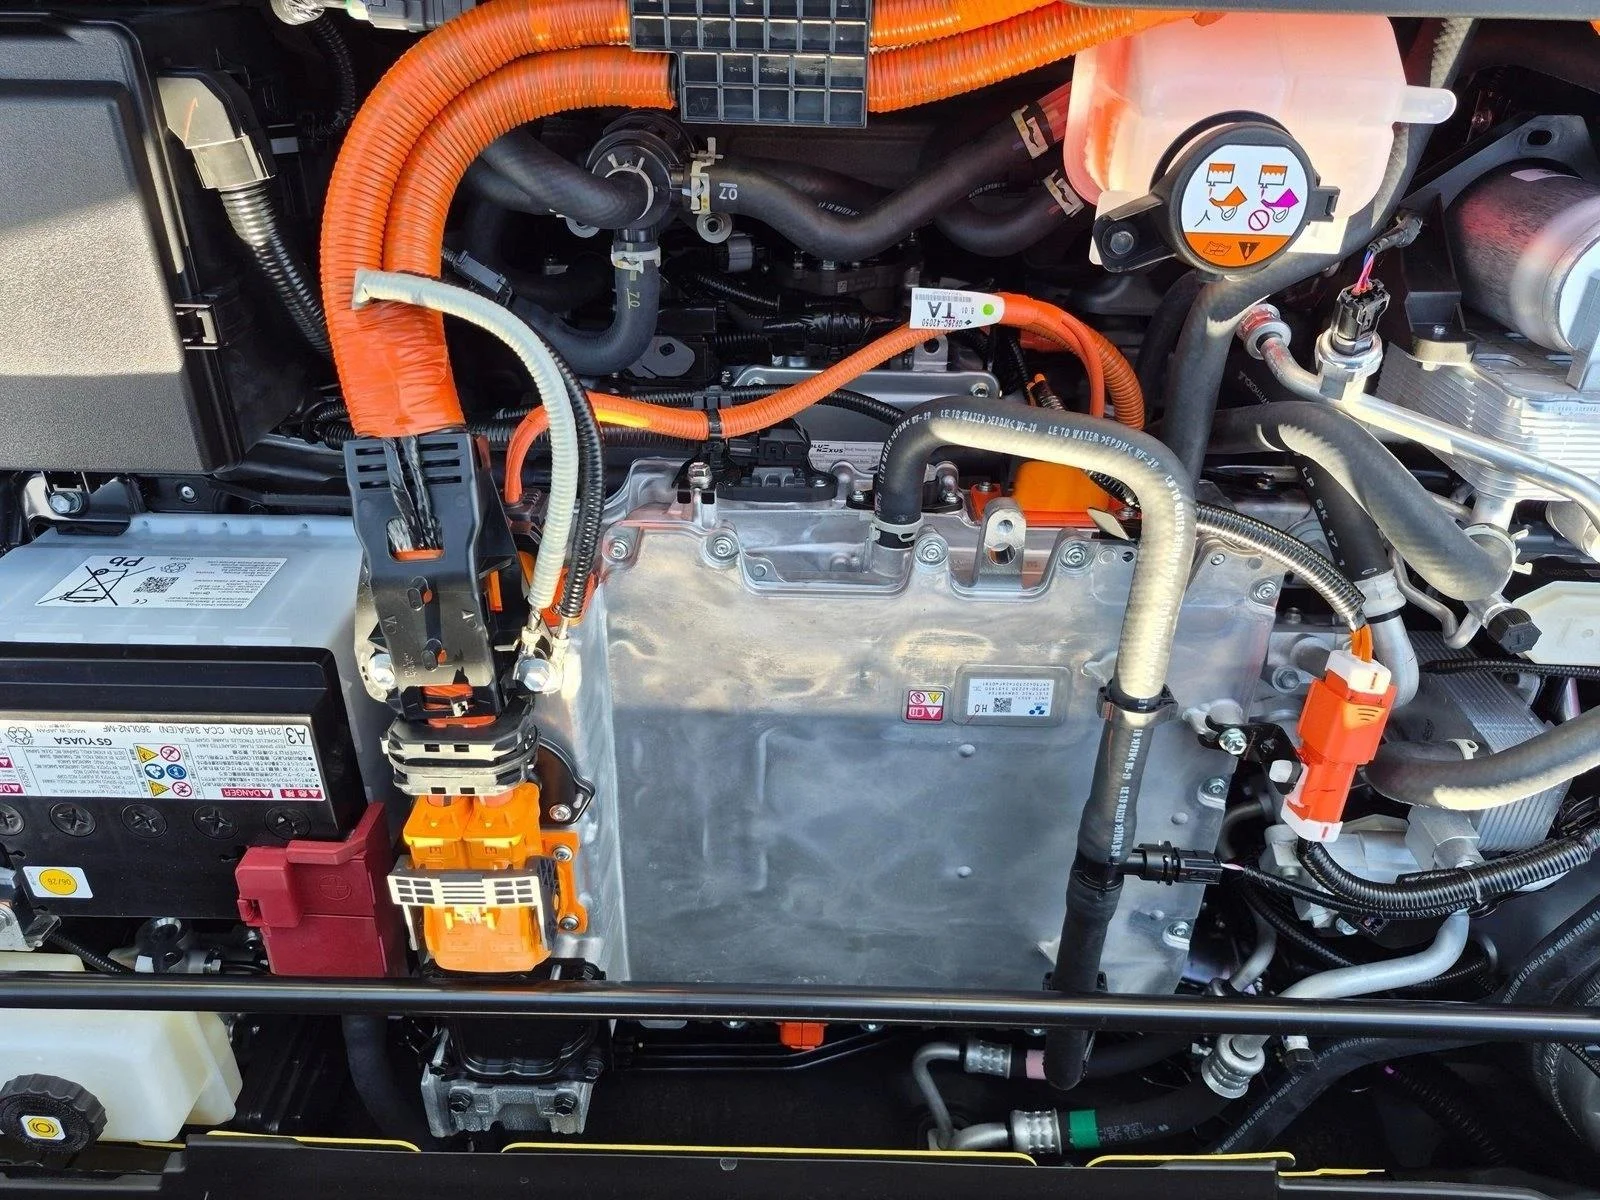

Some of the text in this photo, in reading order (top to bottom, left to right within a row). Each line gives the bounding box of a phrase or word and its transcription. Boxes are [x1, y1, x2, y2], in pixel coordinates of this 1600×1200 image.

[718, 187, 738, 201] 07
[928, 302, 956, 319] TA
[1071, 428, 1099, 443] WATER
[108, 556, 145, 567] Pb
[158, 725, 200, 735] 345A(EN)
[203, 726, 225, 736] CCA
[229, 727, 254, 736] 60Ah
[256, 727, 281, 736] 20HR
[285, 727, 307, 745] A3
[223, 789, 261, 797] DANGER
